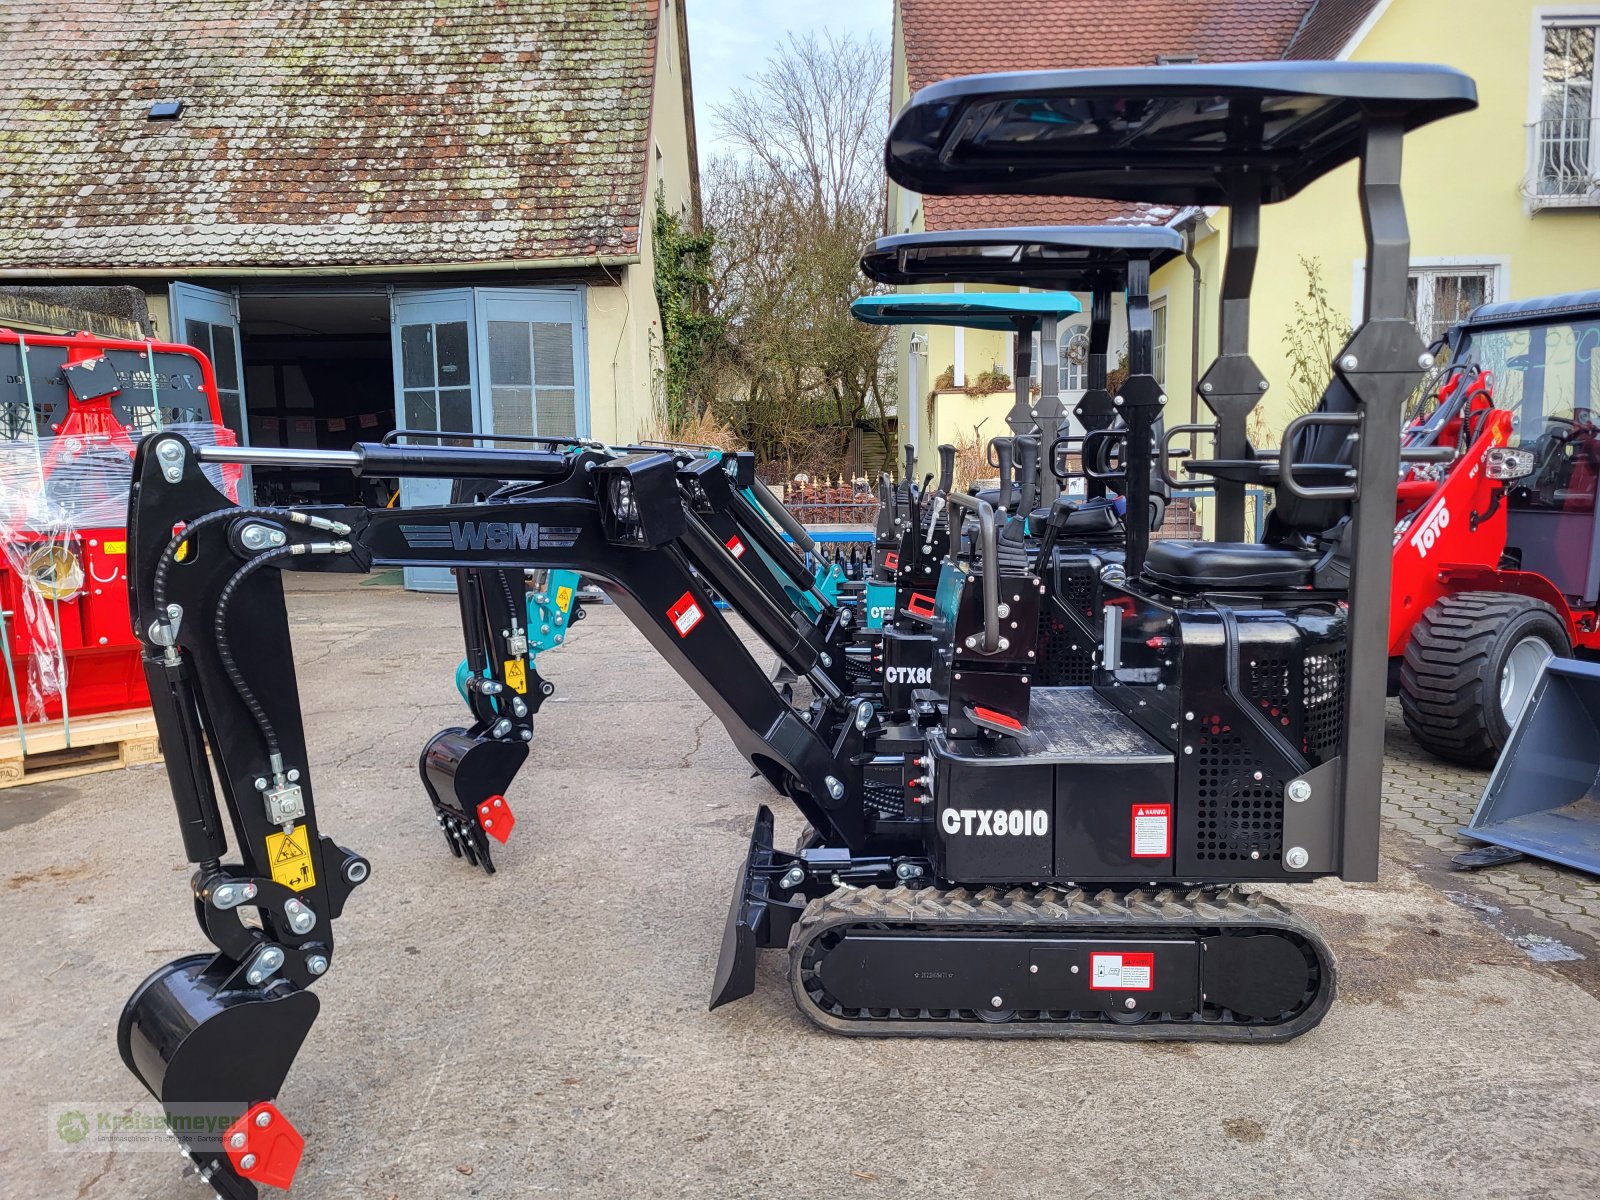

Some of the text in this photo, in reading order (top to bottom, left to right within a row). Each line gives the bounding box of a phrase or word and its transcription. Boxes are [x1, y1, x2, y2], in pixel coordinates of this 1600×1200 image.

[449, 521, 539, 550] WSM
[1410, 496, 1450, 558] TOYO
[941, 808, 1049, 836] CTX8010
